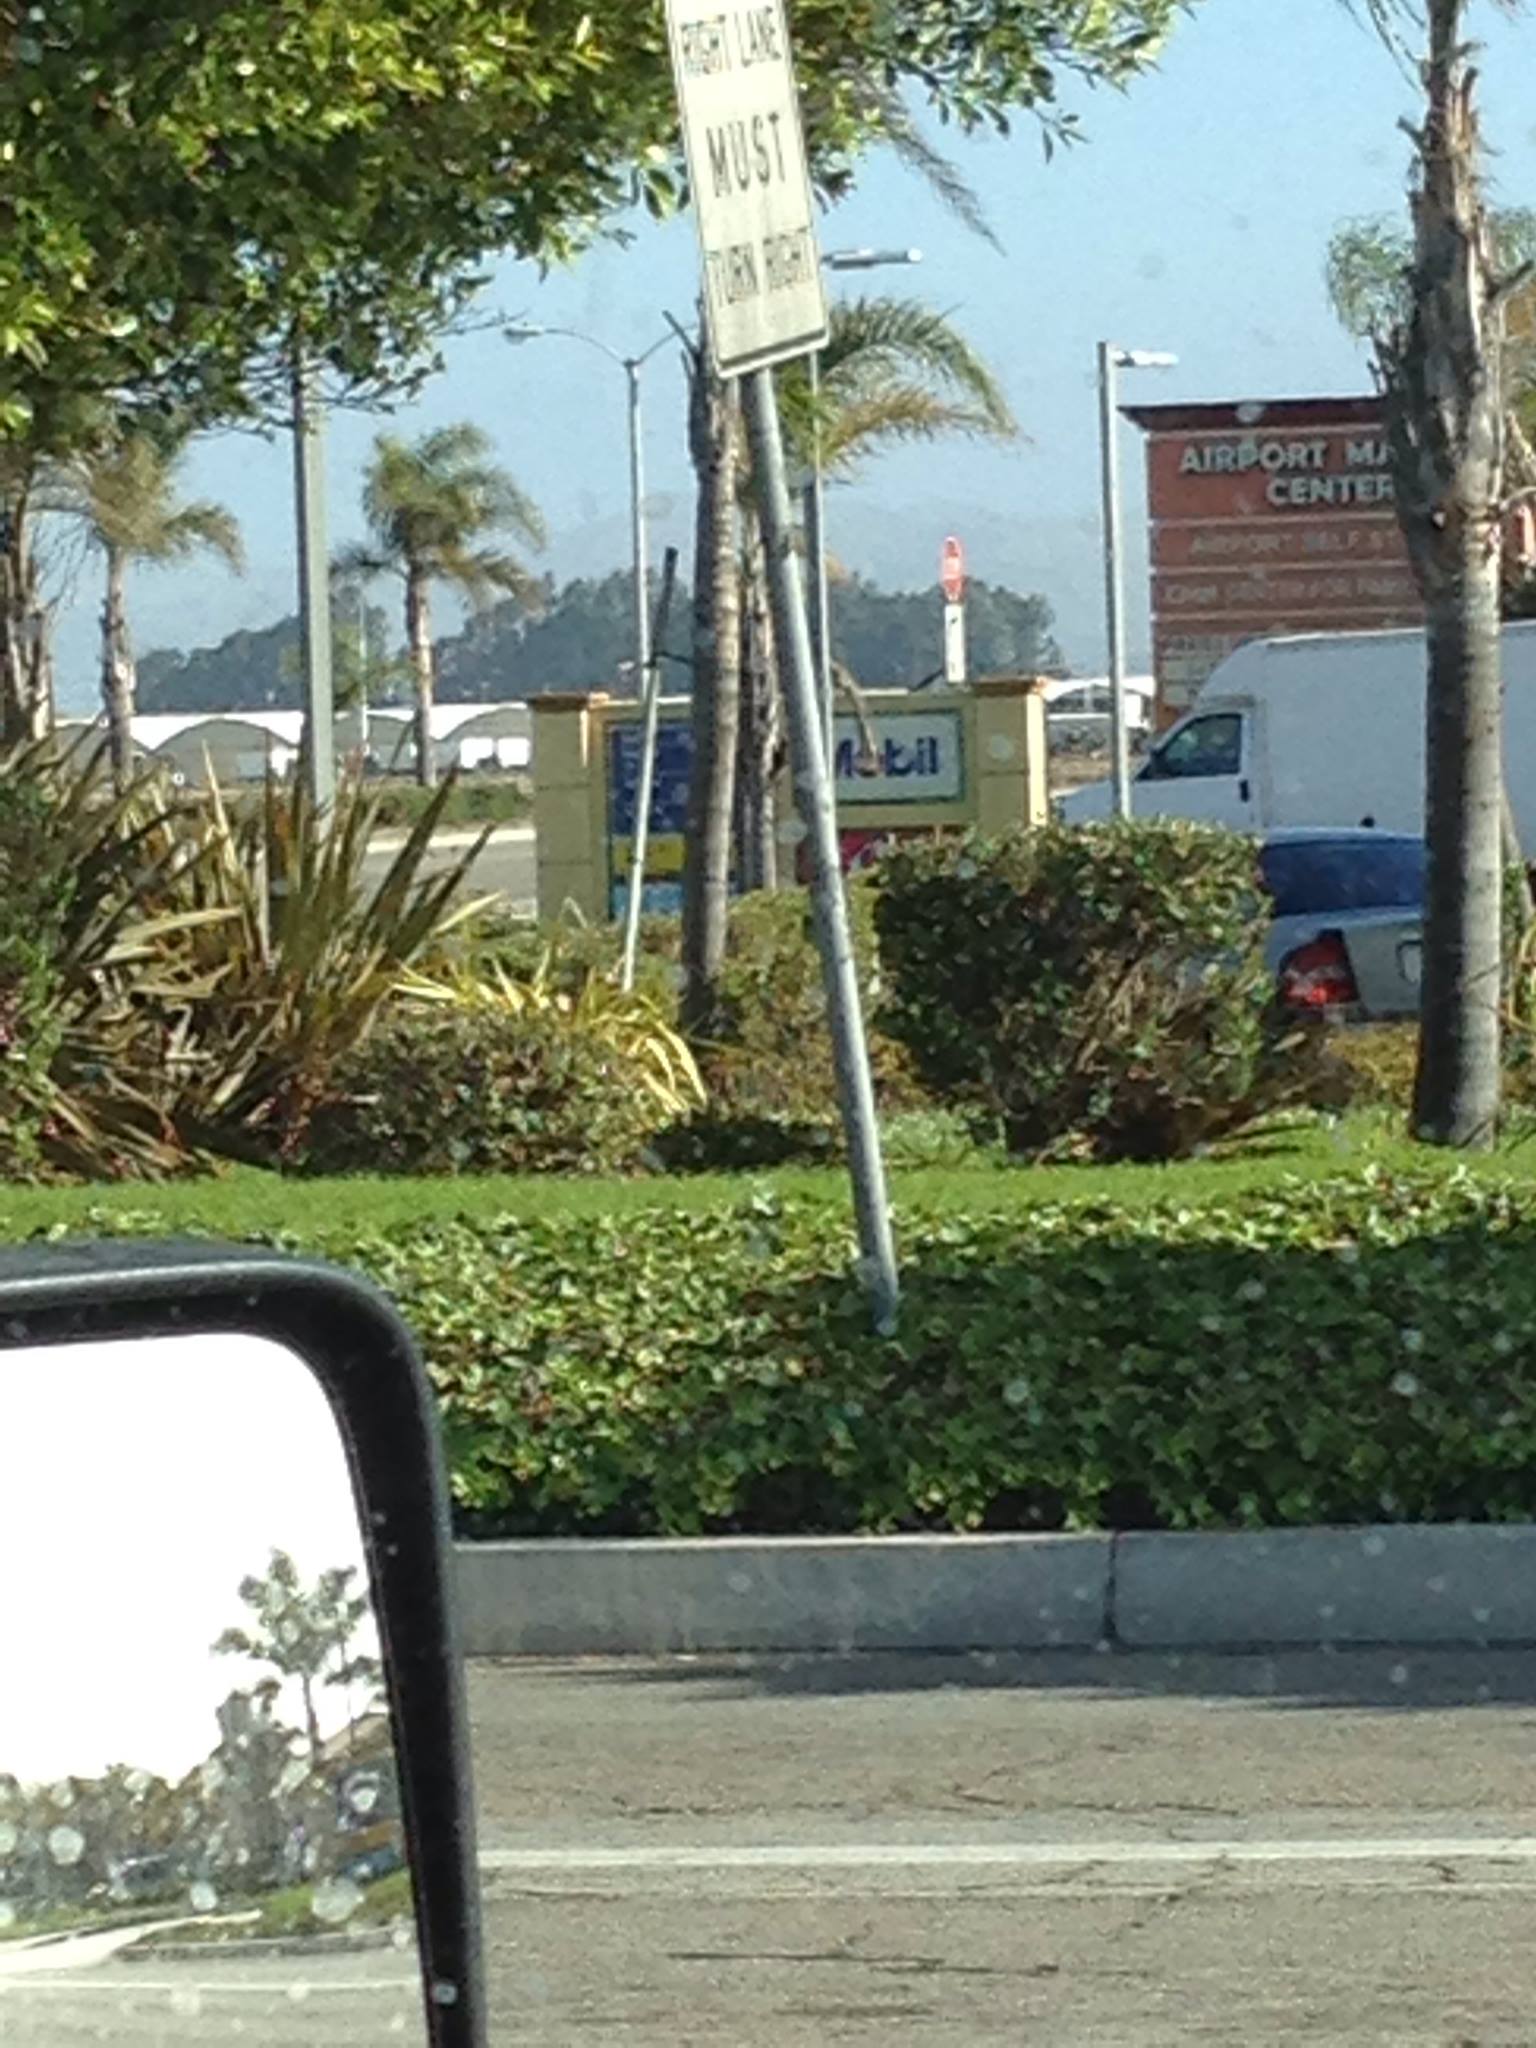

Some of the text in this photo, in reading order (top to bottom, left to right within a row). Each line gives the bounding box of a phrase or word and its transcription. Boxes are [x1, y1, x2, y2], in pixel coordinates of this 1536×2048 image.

[706, 112, 786, 198] MUST
[1180, 441, 1328, 474] AIRPORT
[1265, 474, 1396, 507] CENTER
